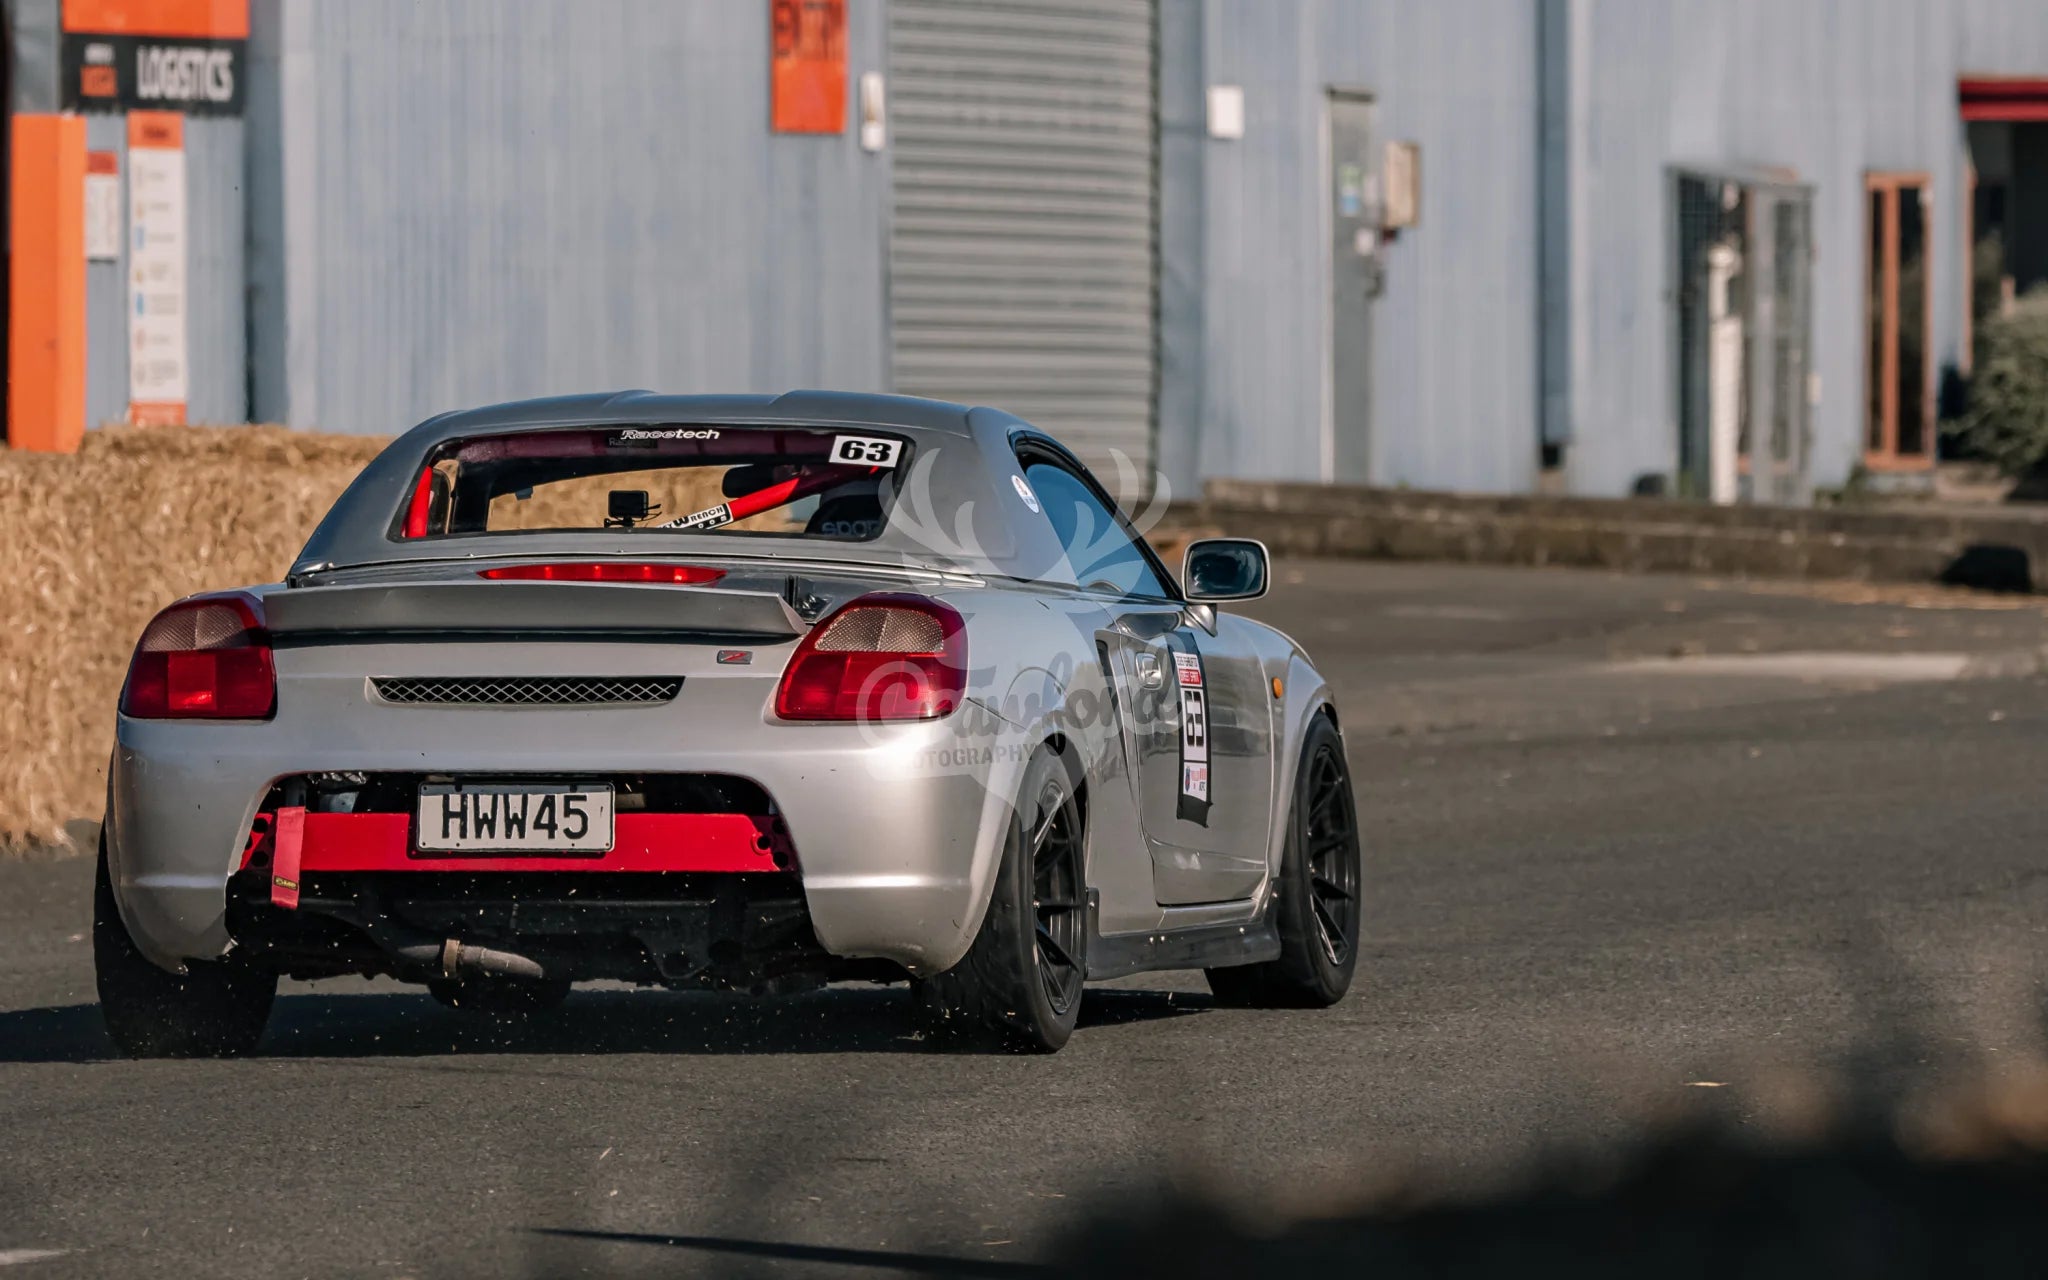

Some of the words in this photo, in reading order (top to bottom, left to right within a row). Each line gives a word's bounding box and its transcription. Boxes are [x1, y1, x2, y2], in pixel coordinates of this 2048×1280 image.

[136, 45, 233, 101] LOGISTICS
[620, 428, 720, 440] Racetech
[839, 439, 892, 462] 63
[440, 793, 590, 840] HWW45
